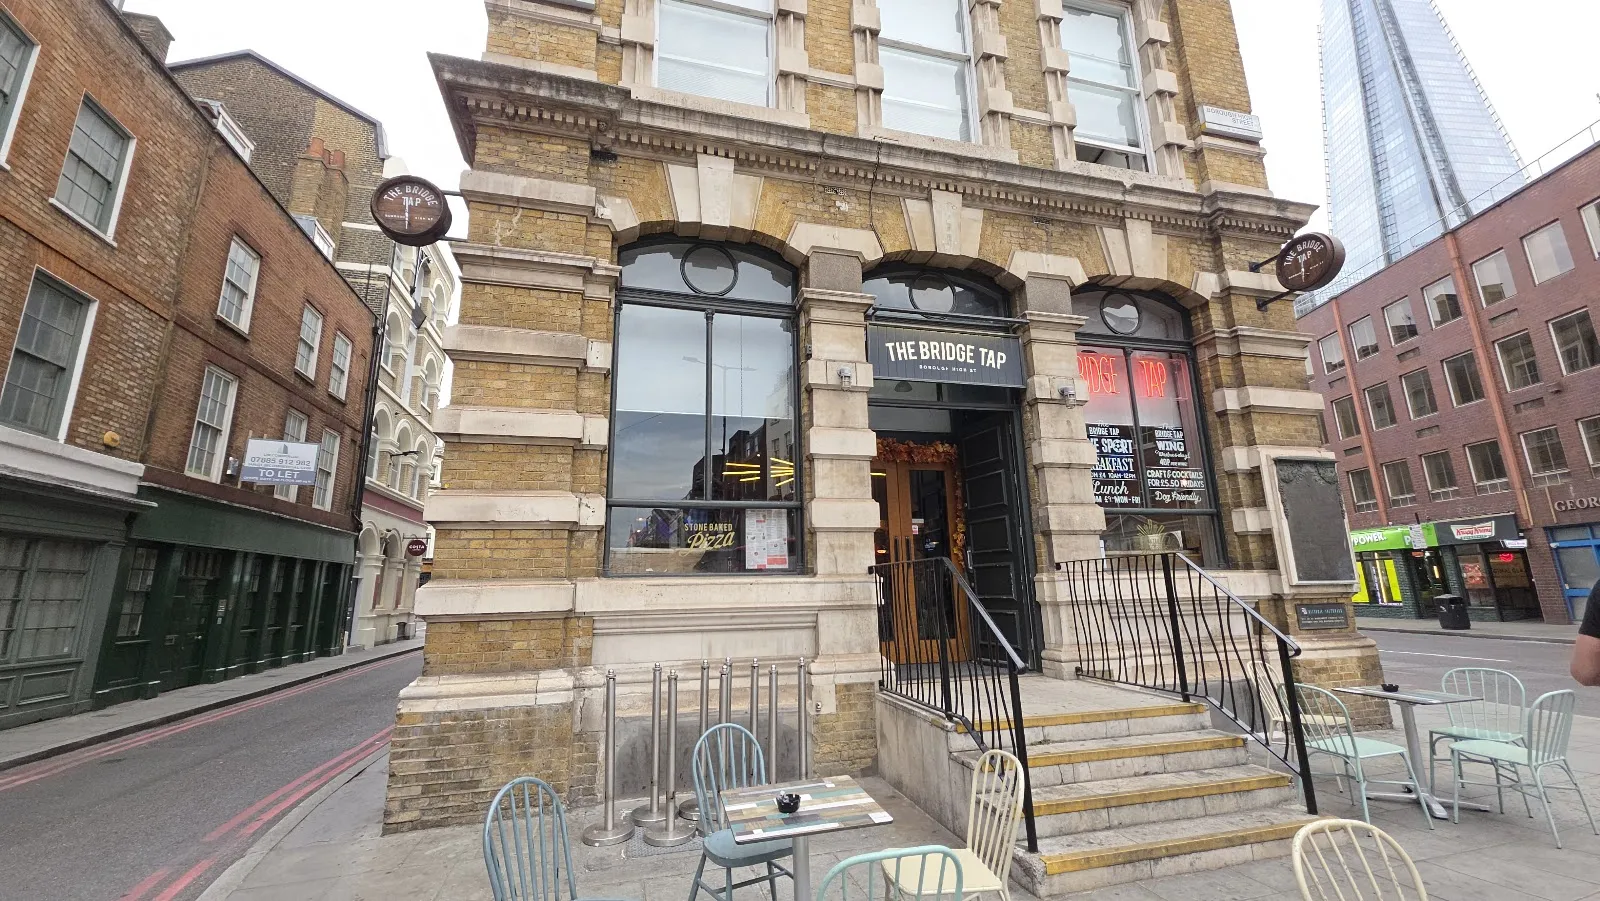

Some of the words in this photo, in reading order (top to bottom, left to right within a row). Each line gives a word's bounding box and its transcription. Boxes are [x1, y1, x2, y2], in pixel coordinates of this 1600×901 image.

[1206, 107, 1237, 118] BOROUGH
[1232, 118, 1254, 127] STREET
[383, 186, 403, 201] THE
[405, 185, 438, 206] BRIDGE
[402, 196, 421, 207] TAP
[1283, 250, 1297, 267] THE
[1296, 240, 1324, 253] BRIDGE
[1296, 250, 1312, 263] TAP
[885, 340, 918, 362] THE
[918, 340, 975, 364] BRIDGE
[978, 347, 1007, 370] TAP
[1077, 356, 1121, 394] RIDGE
[1139, 360, 1168, 397] TAP
[1088, 426, 1108, 435] BRIDGE
[1108, 427, 1120, 436] TAP
[1154, 429, 1173, 439] BRIDGE
[1173, 430, 1184, 439] TAP
[1101, 438, 1133, 454] SPORT
[1156, 440, 1185, 452] WING
[278, 458, 294, 466] 912
[258, 469, 275, 477] TO
[277, 470, 300, 479] LET
[1146, 470, 1167, 478] CRAFT
[1171, 470, 1204, 480] COCKTAILS
[1093, 480, 1129, 495] Lunch
[1147, 479, 1160, 487] FOR
[1160, 479, 1180, 488] £5.50
[1154, 490, 1172, 504] Dog
[1171, 490, 1202, 505] Friendly
[1554, 496, 1600, 512] GEOR
[684, 523, 708, 532] STONE
[708, 523, 733, 532] BAKED
[679, 531, 736, 558] Pizza
